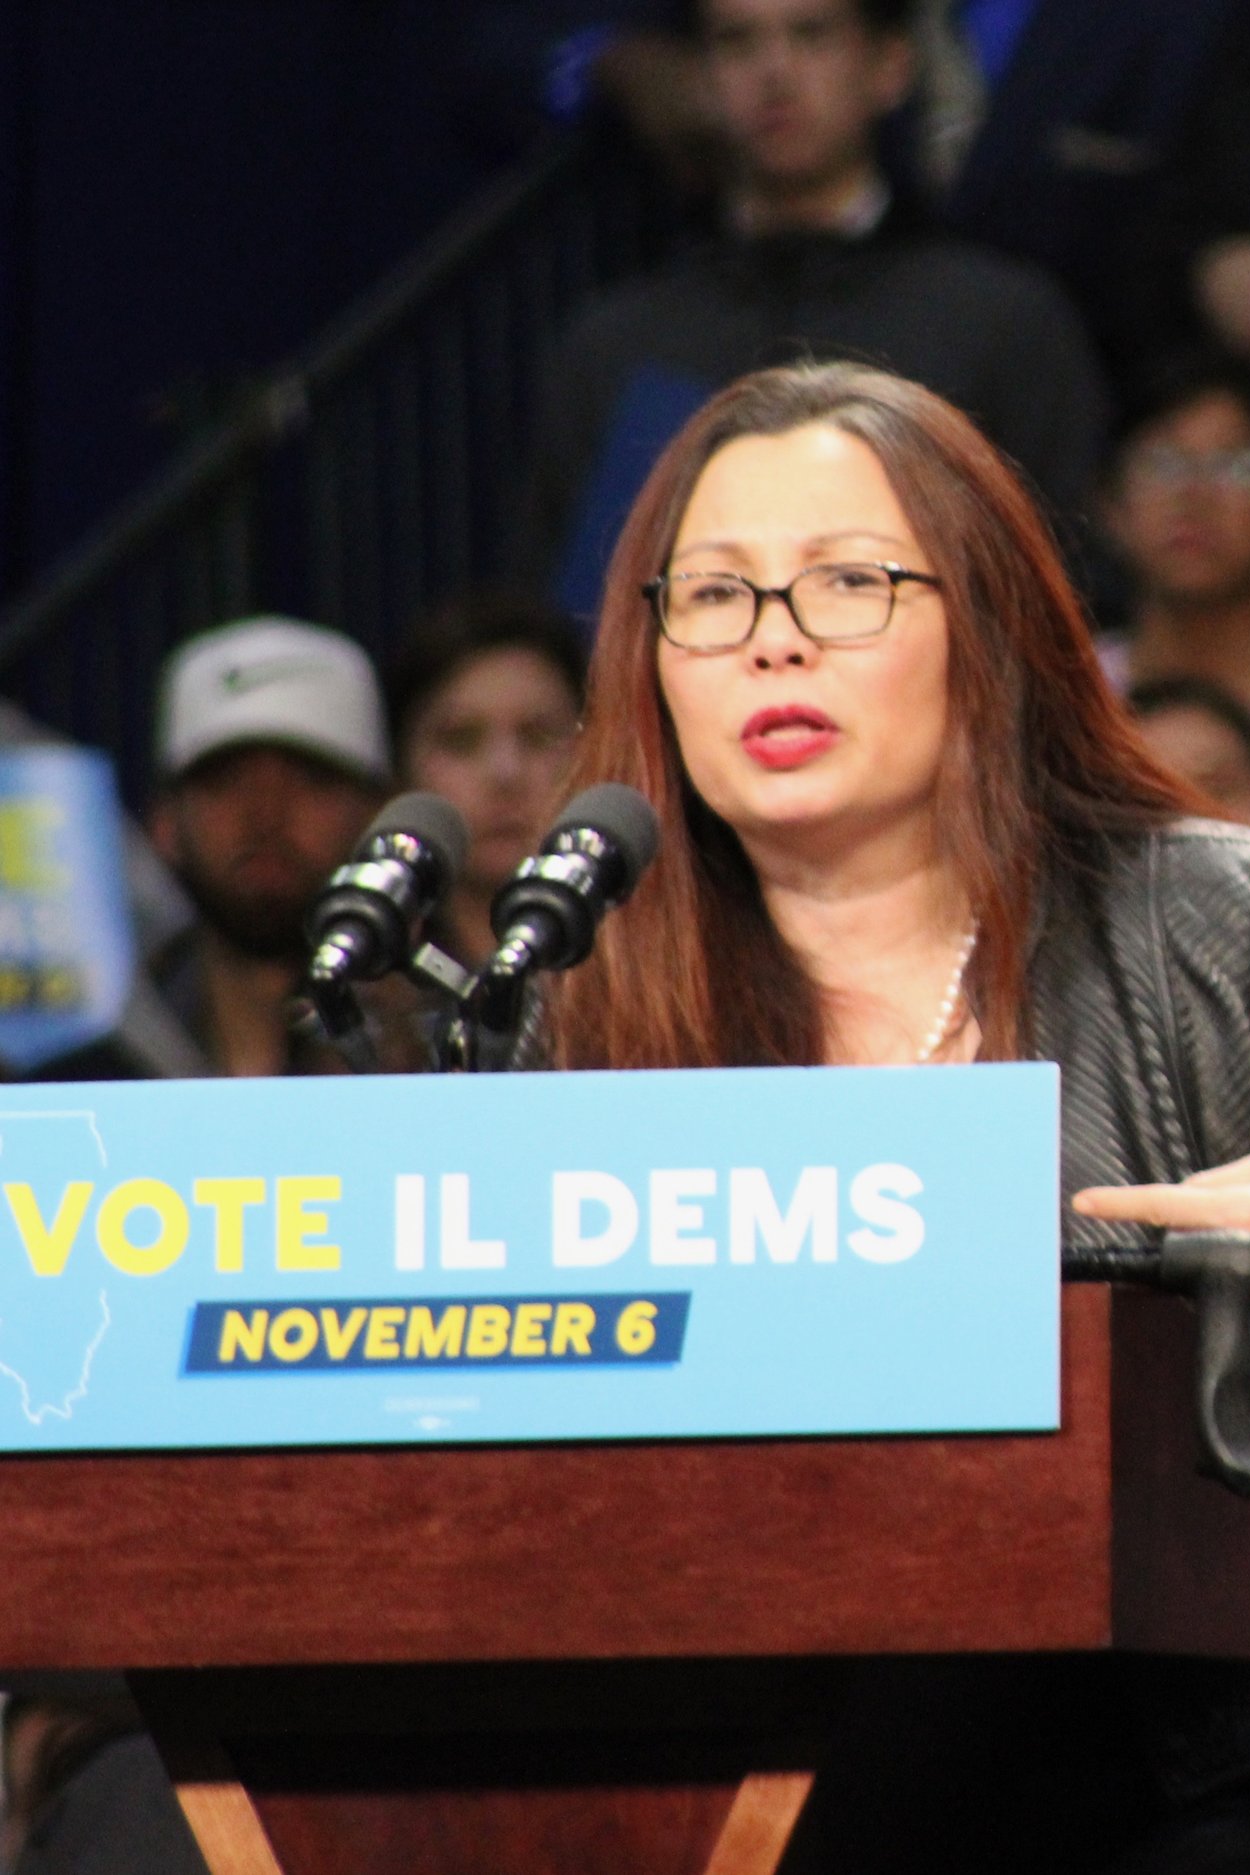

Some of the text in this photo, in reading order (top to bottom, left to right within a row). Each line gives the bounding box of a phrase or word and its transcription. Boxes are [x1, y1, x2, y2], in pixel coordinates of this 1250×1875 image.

[3, 1162, 926, 1277] VOTE IL DEMS
[218, 1301, 658, 1362] NOVEMBER 6
